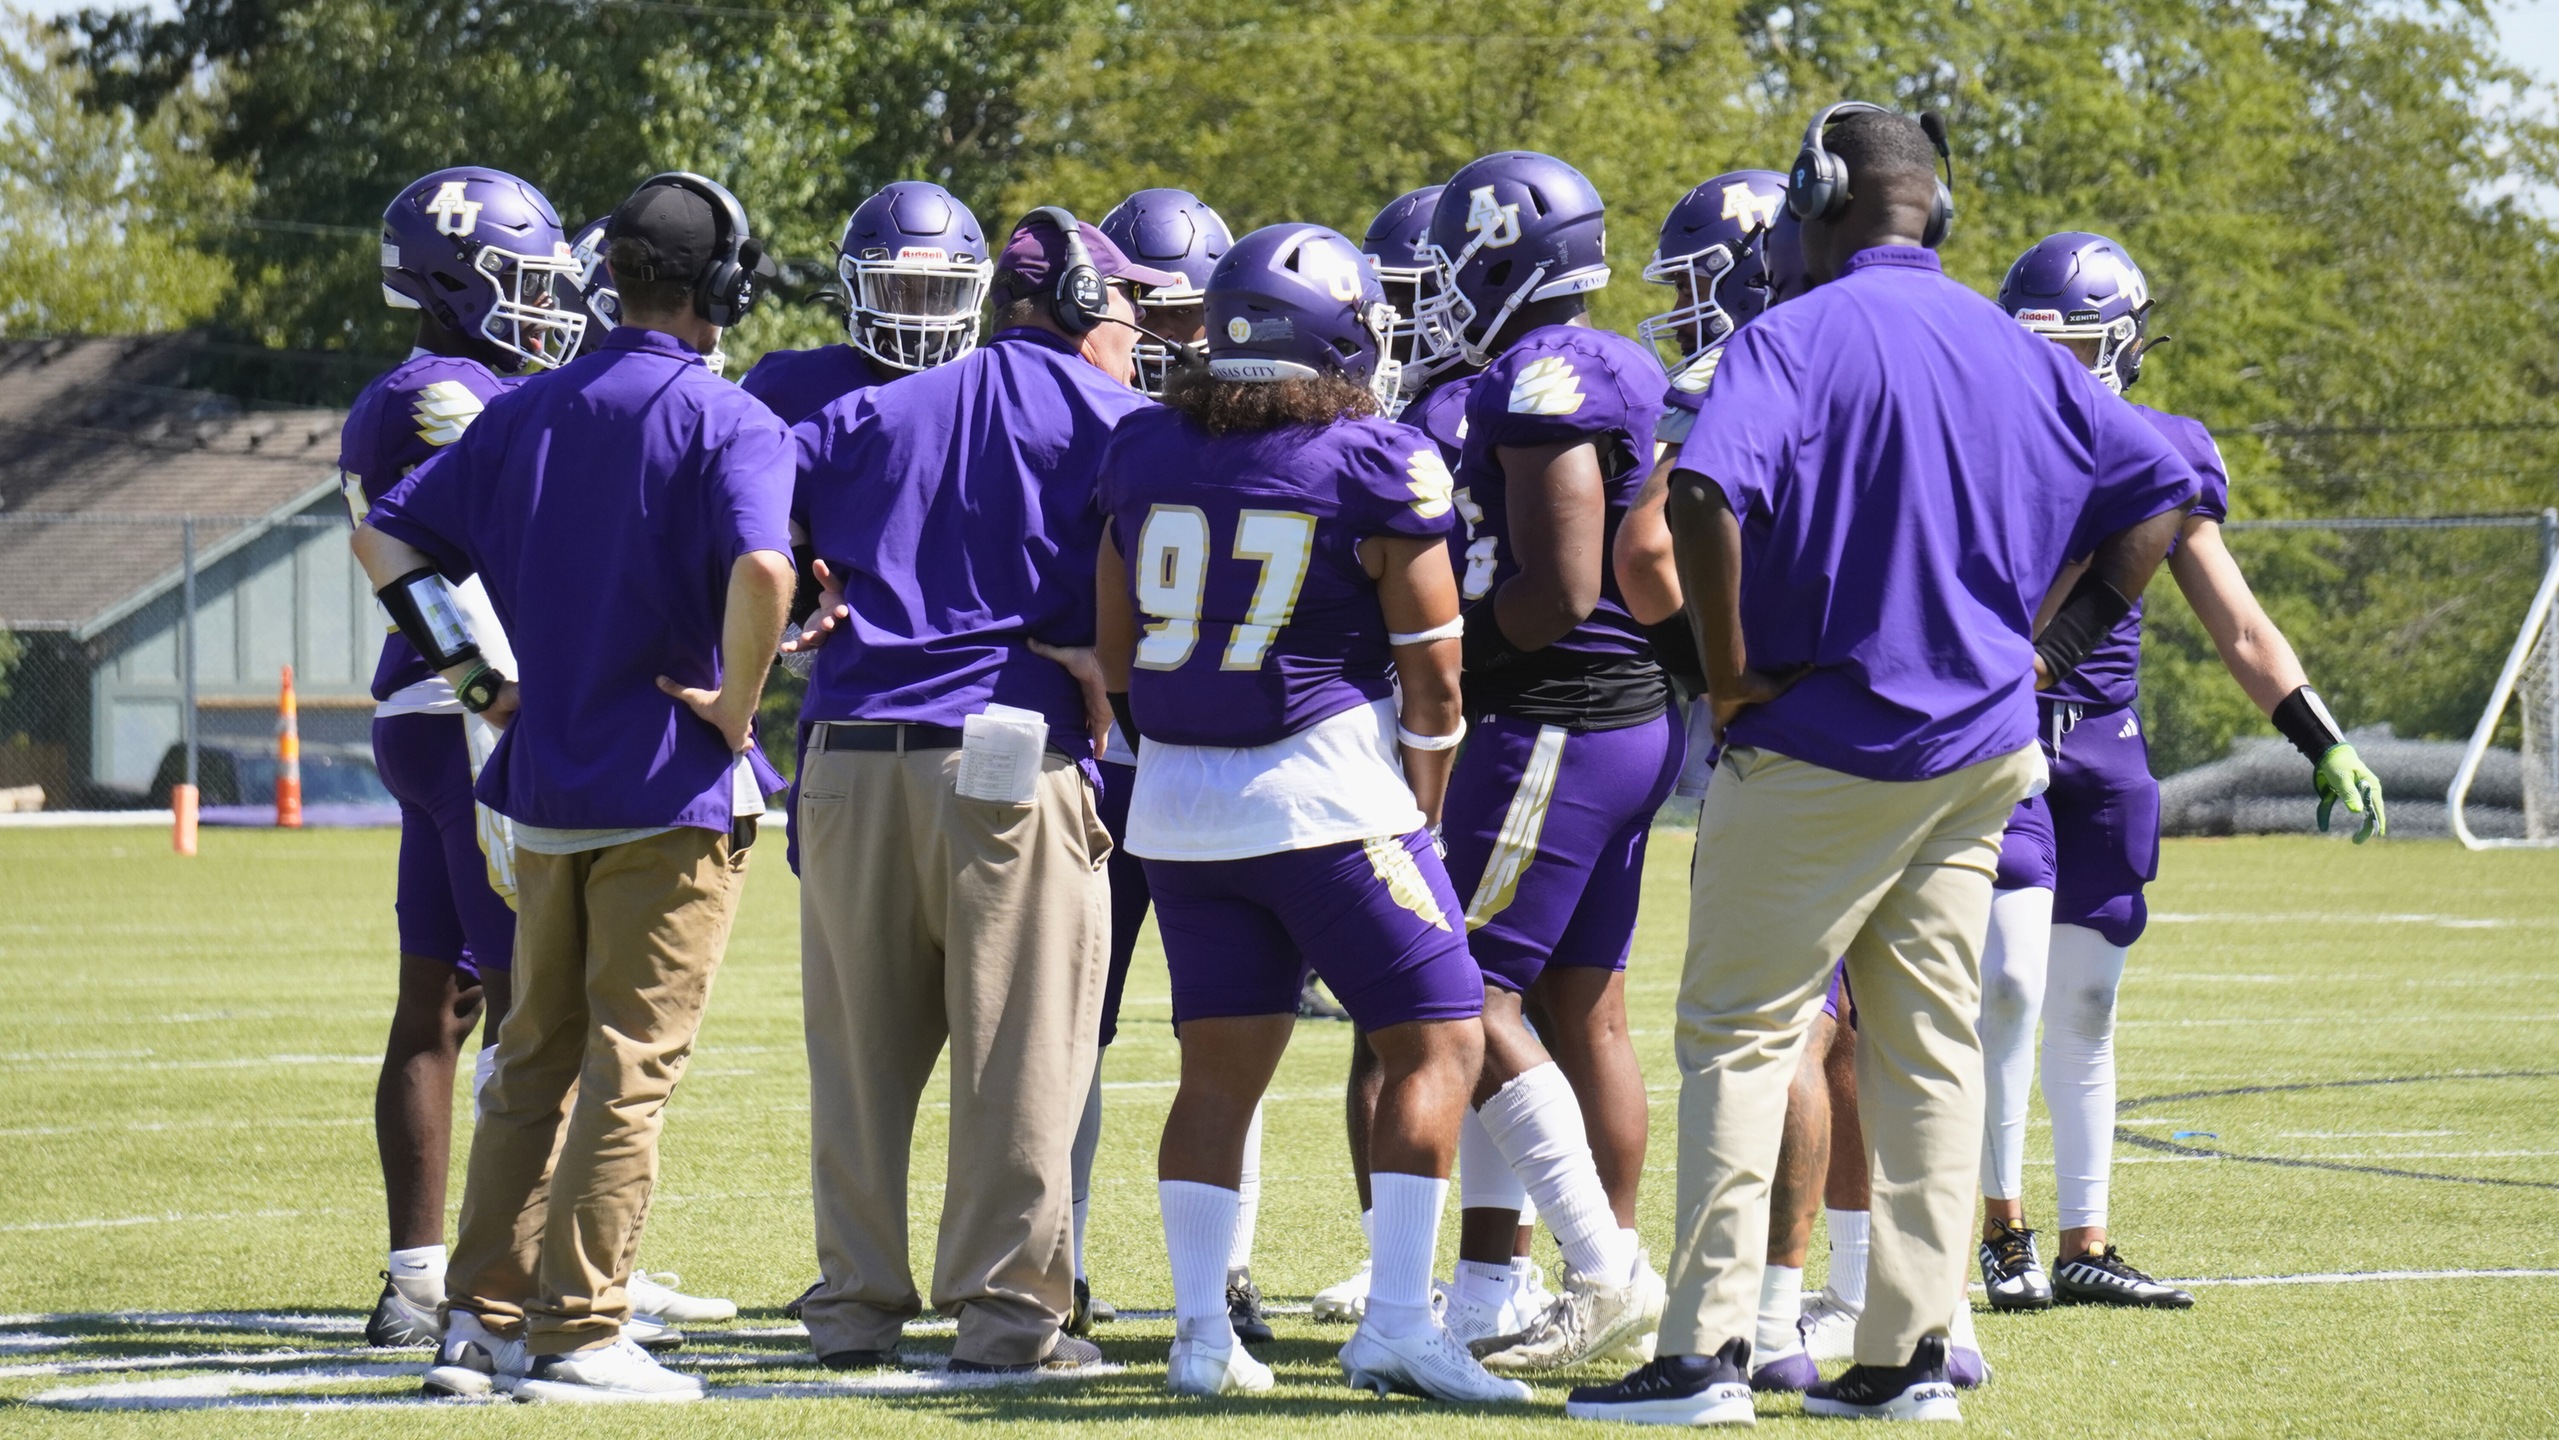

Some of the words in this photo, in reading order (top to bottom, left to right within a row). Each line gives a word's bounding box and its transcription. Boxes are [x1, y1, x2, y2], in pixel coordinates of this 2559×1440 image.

[425, 181, 484, 237] AU
[1465, 185, 1522, 249] AU
[902, 250, 942, 259] Riddell
[2019, 312, 2055, 321] Riddell
[2069, 313, 2099, 322] XENITH
[1230, 322, 1248, 338] 97
[1242, 366, 1276, 377] CITY
[1133, 503, 1319, 671] 97
